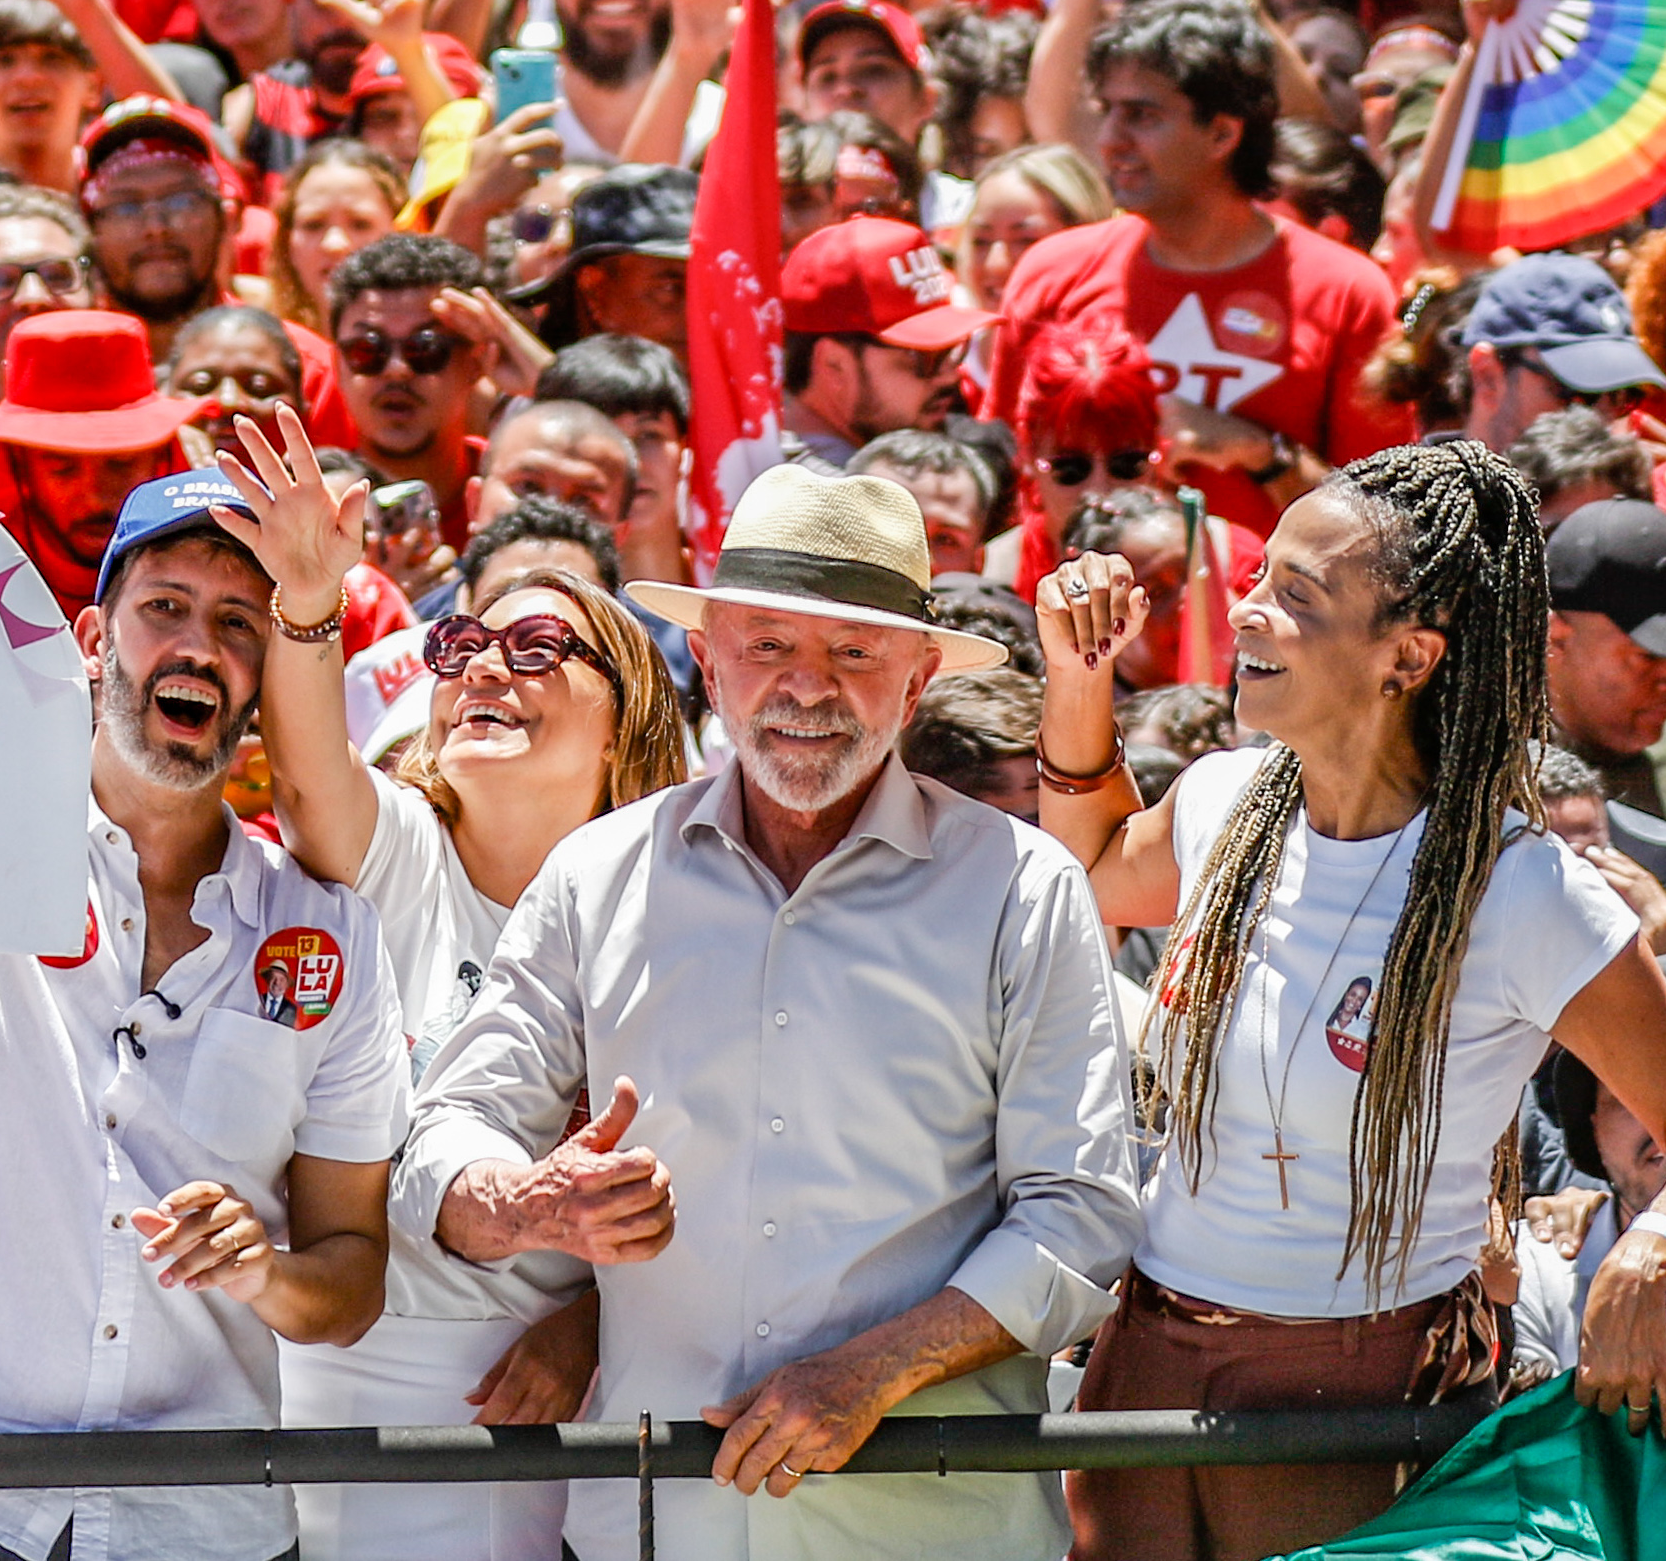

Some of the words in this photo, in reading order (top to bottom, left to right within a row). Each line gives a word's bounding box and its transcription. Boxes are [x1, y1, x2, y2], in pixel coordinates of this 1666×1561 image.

[266, 945, 296, 957] VOTE
[299, 938, 315, 954] 13
[300, 957, 334, 975] LU
[298, 975, 328, 992] LA
